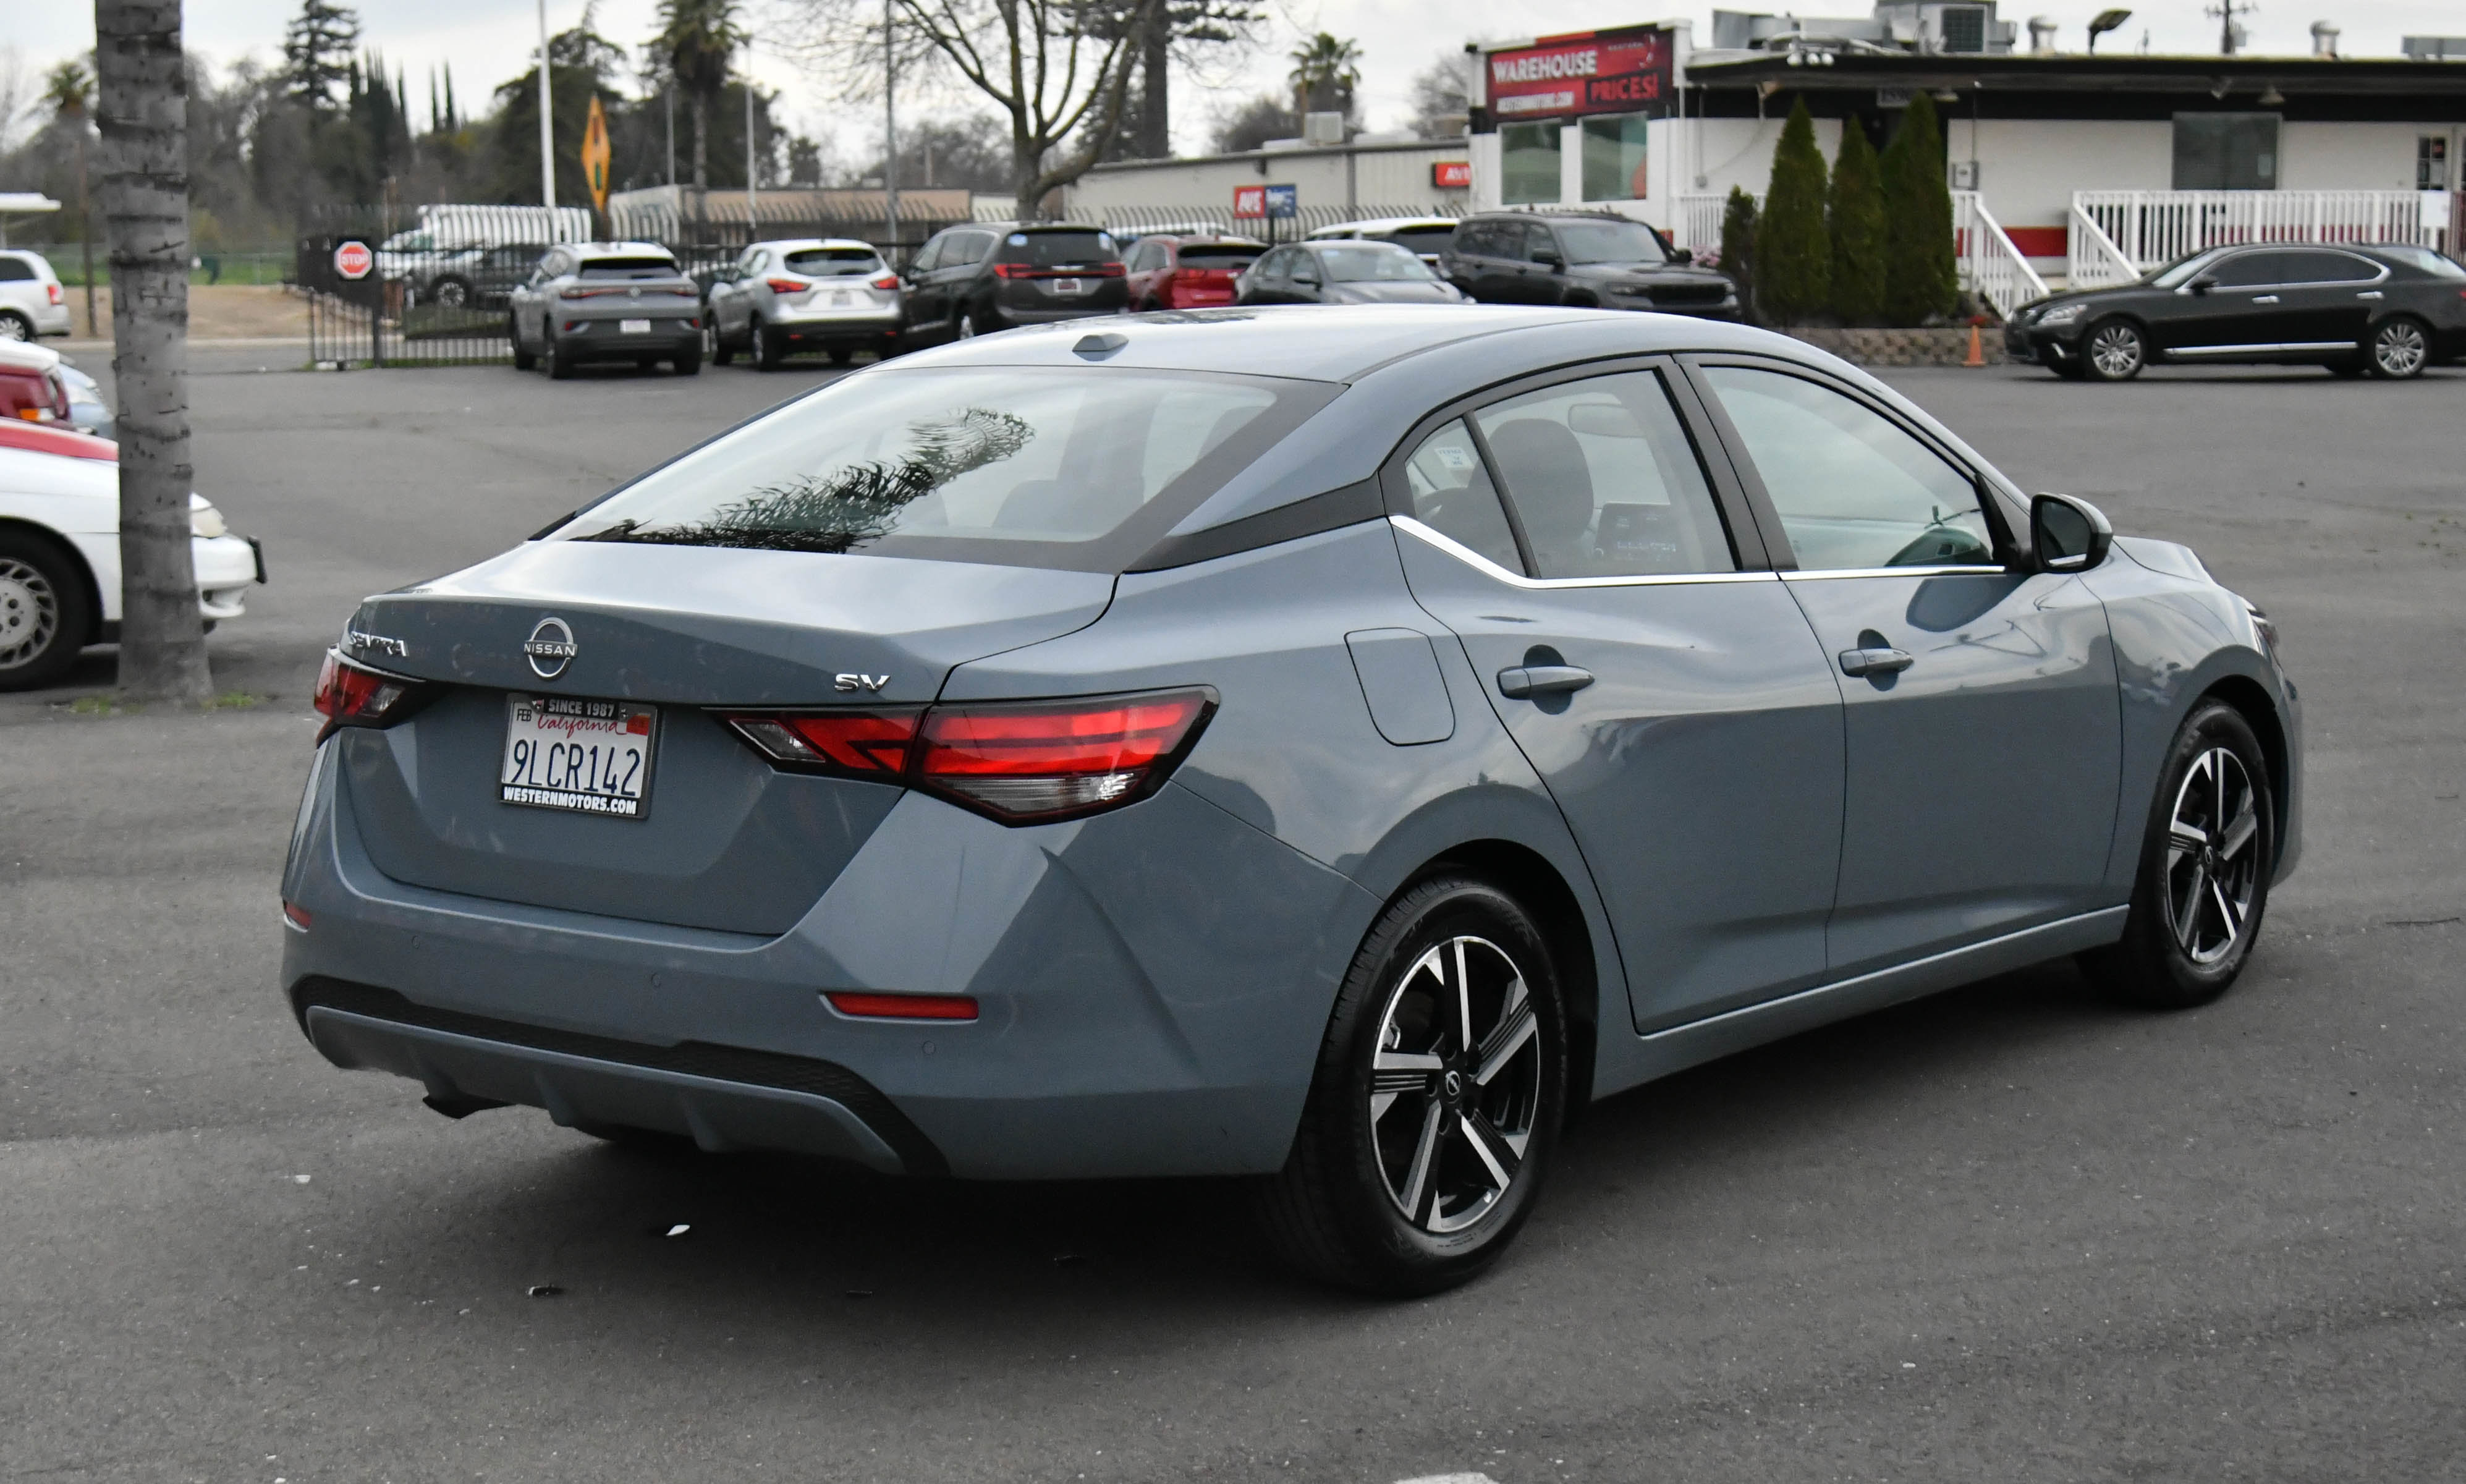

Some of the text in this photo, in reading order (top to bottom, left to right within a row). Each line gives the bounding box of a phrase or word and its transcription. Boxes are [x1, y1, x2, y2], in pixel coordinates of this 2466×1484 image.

[1491, 49, 1598, 83] WAREHOUSE
[341, 253, 369, 266] STOP
[524, 642, 575, 656] NISSAN
[834, 673, 891, 691] SV
[517, 708, 532, 722] FEB
[548, 699, 614, 717] SINCE 1987
[537, 714, 627, 739] California
[511, 739, 640, 797] 9LCR142
[504, 786, 637, 815] WESTERNMOTORS.COM
